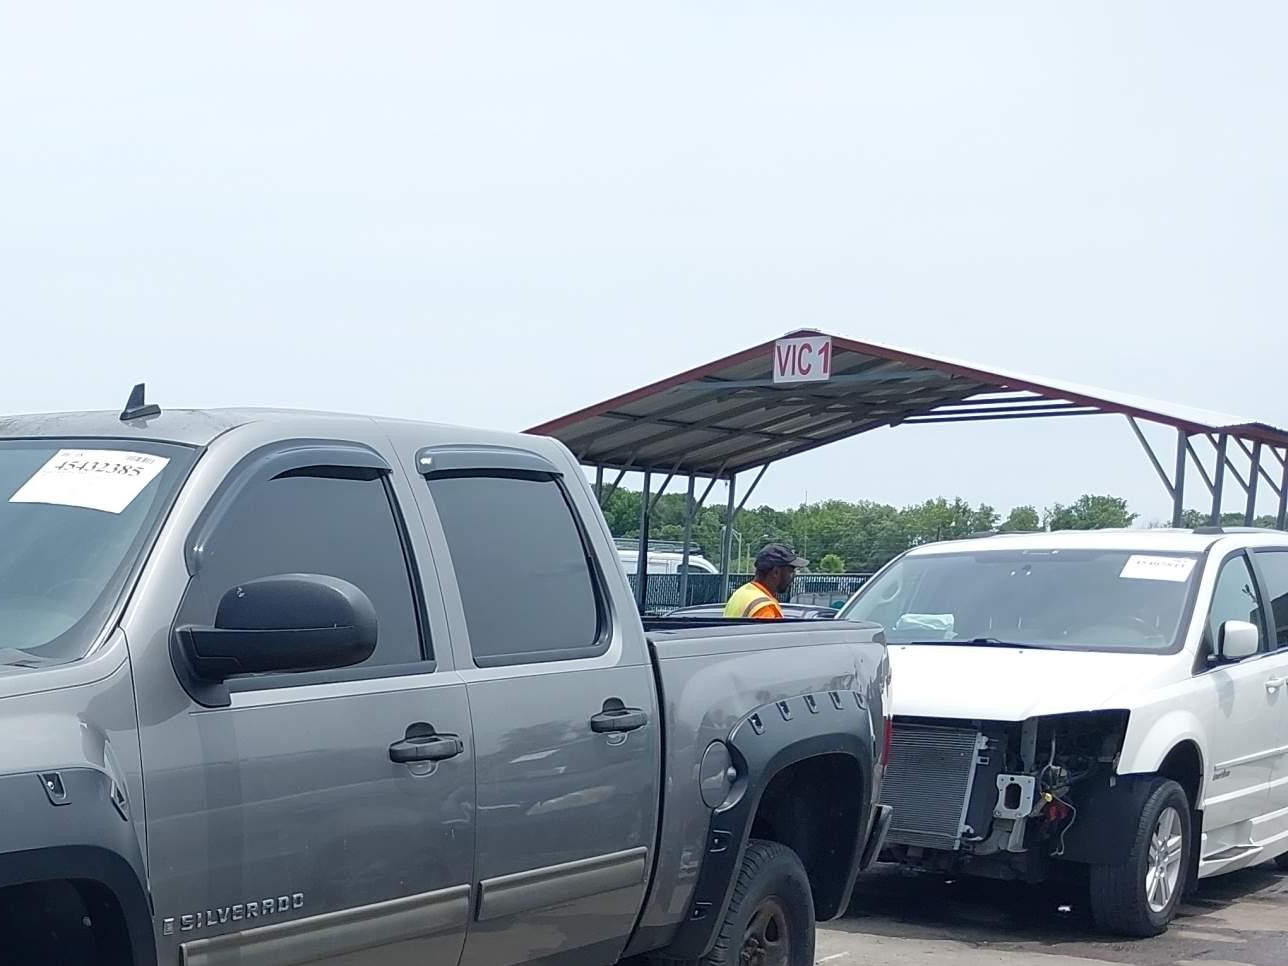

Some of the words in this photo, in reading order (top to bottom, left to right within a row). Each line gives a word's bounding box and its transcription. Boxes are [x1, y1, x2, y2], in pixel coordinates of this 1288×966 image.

[776, 342, 813, 377] VIC
[817, 341, 830, 375] 1
[54, 460, 145, 477] 45432385
[180, 892, 304, 931] SILVERADO
